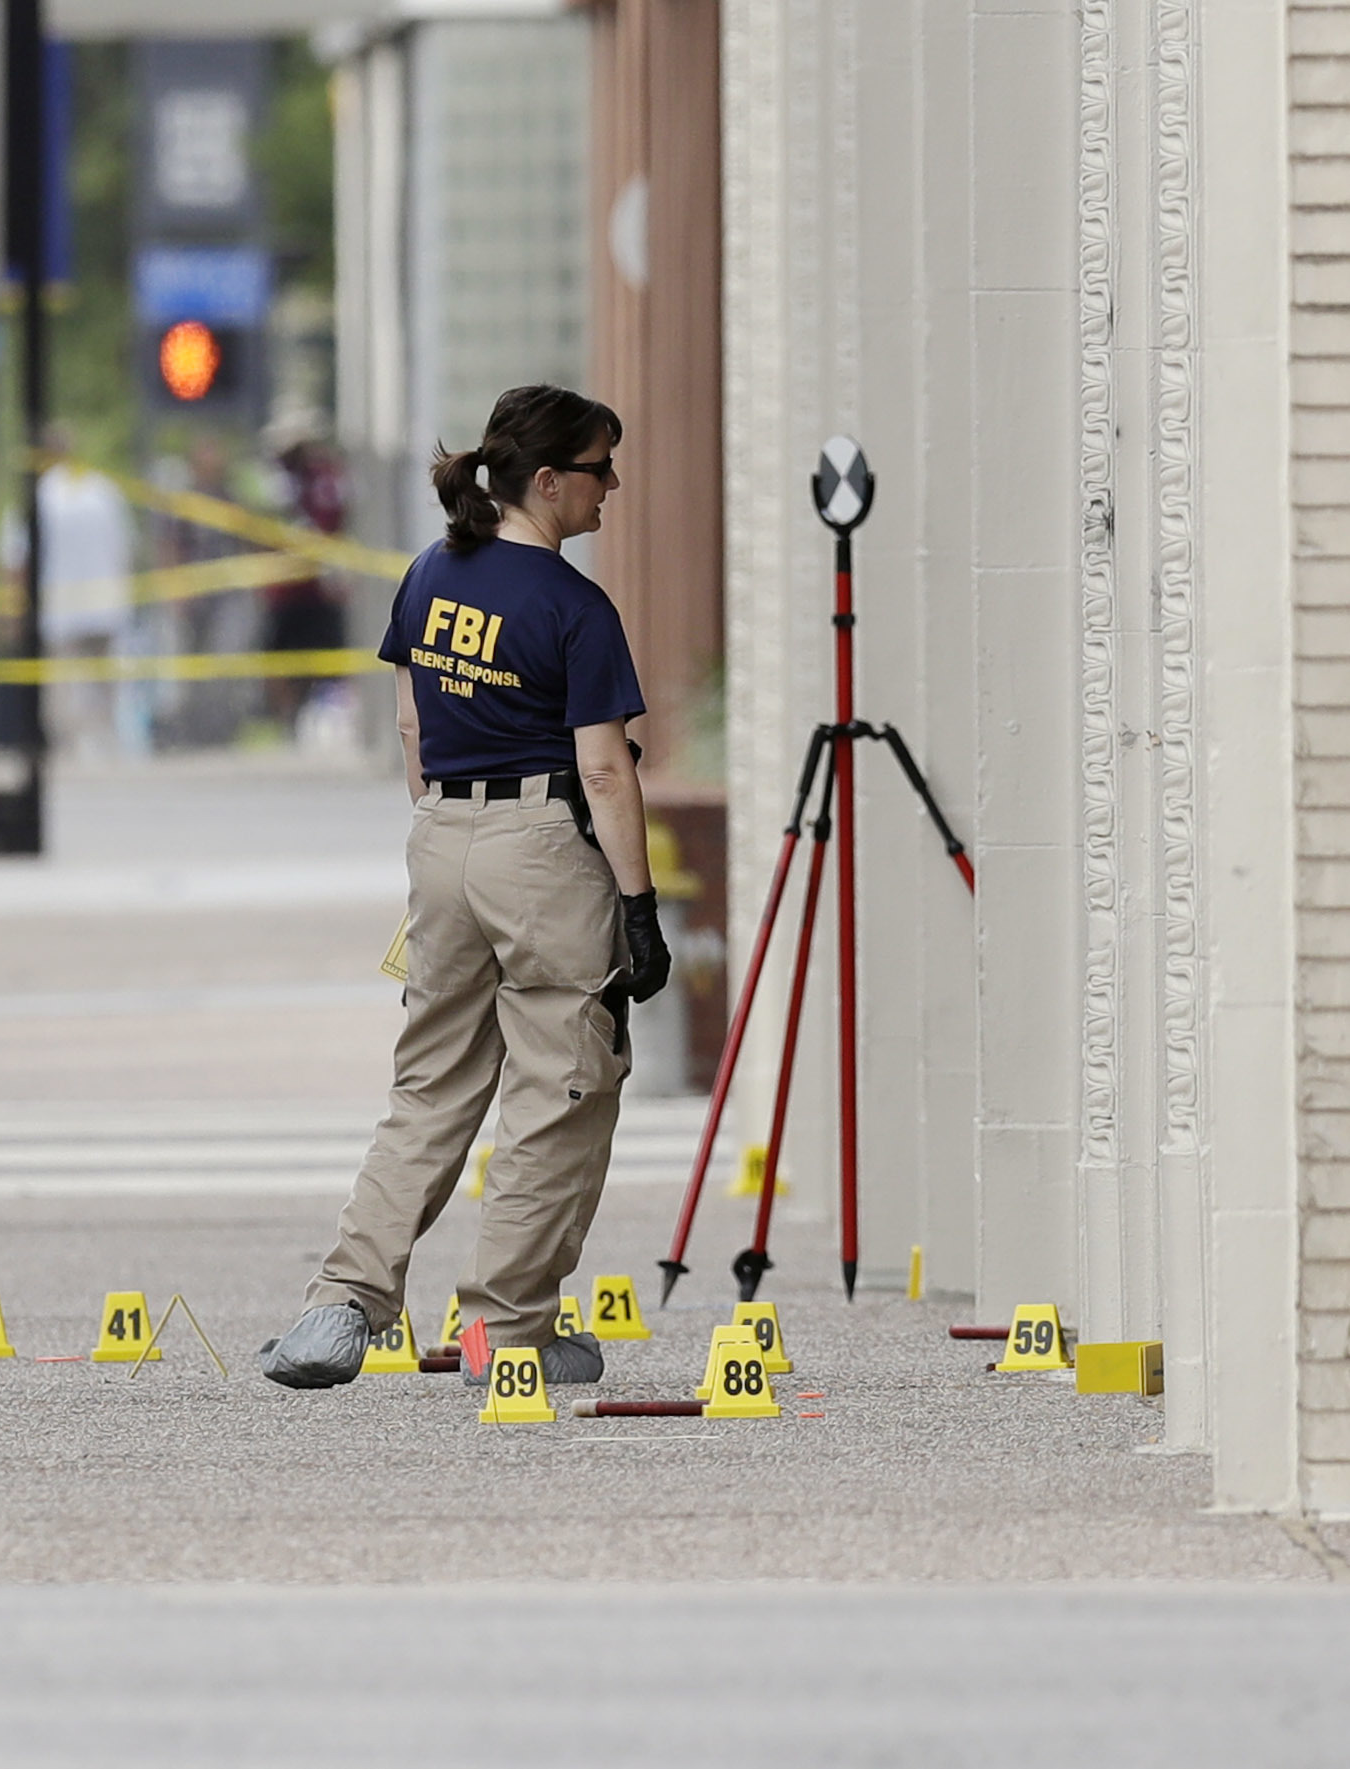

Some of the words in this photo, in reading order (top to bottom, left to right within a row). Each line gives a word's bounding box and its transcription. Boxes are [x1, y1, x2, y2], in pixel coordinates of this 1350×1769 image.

[423, 597, 503, 663] FBI
[439, 676, 473, 698] TEAM
[599, 1289, 631, 1321] 21
[108, 1308, 141, 1340] 41
[1014, 1320, 1054, 1355] 59
[495, 1360, 538, 1398] 89
[723, 1360, 763, 1396] 88
